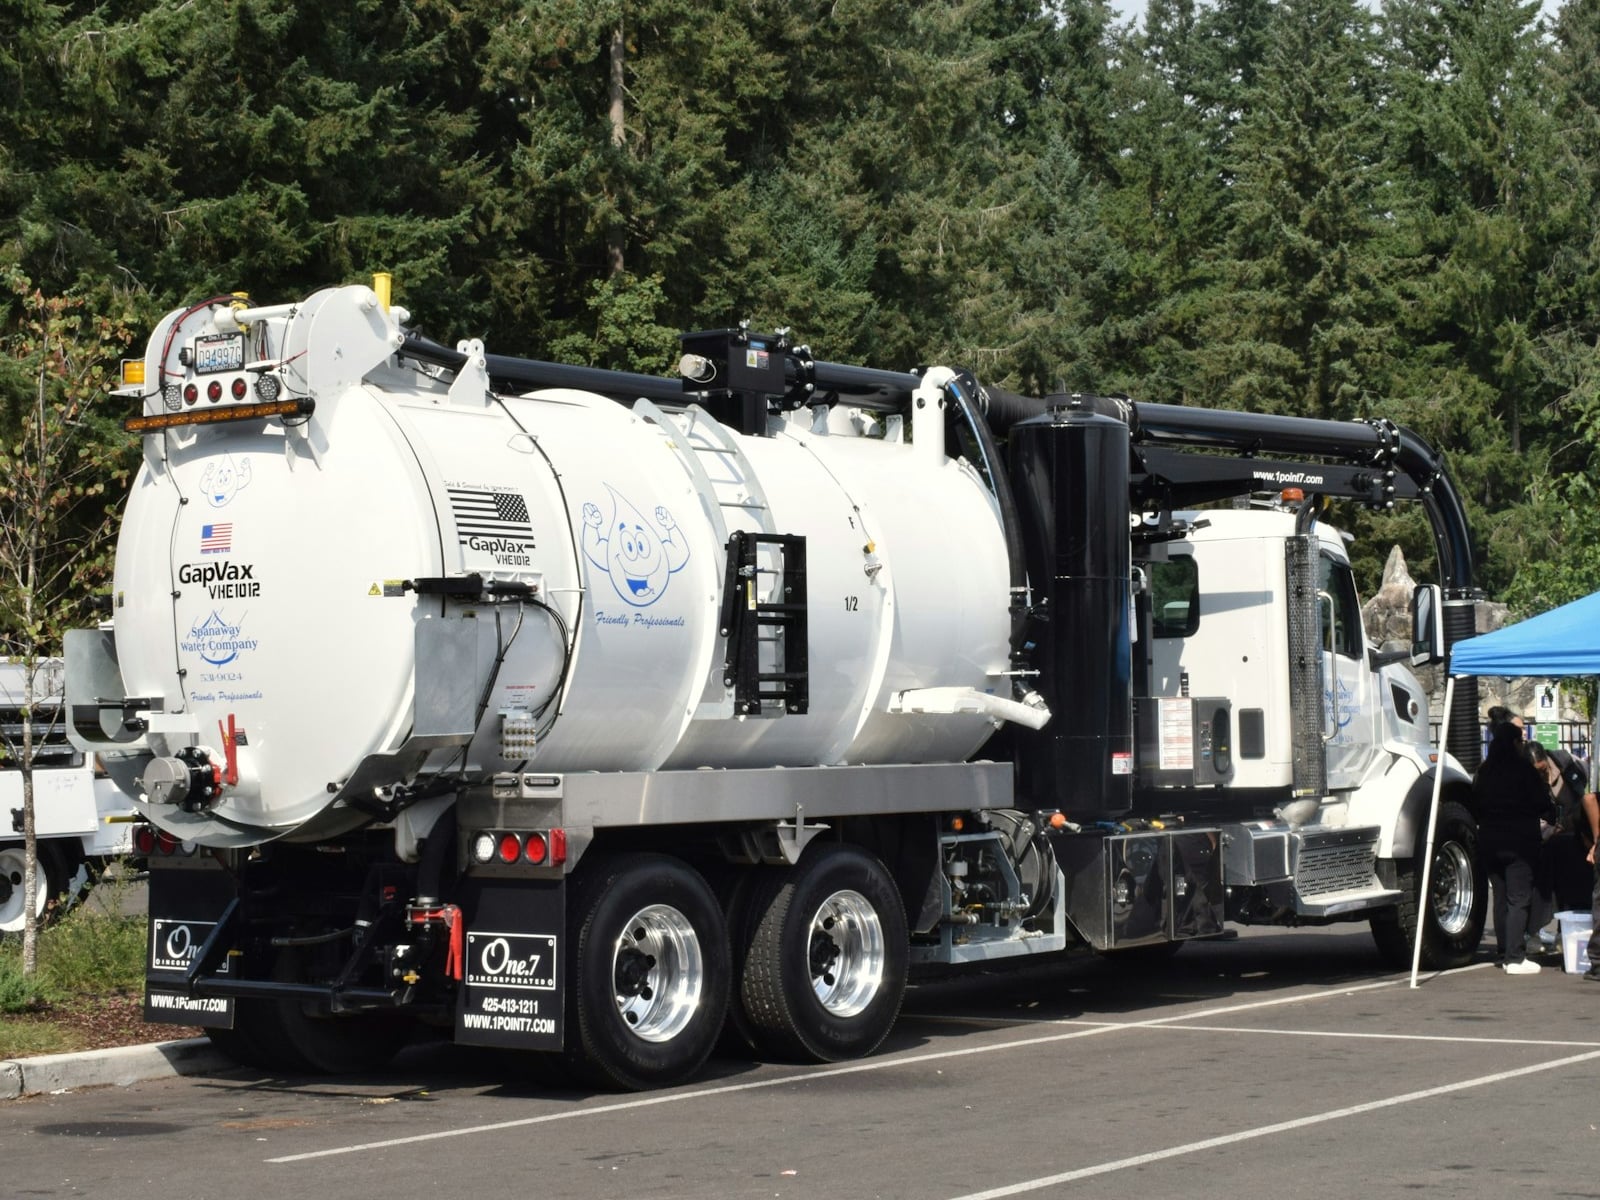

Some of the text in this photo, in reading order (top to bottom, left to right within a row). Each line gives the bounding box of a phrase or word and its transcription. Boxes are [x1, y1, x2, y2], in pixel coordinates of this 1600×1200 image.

[1253, 471, 1323, 484] www.1point7.com
[469, 536, 524, 555] GapVax
[495, 554, 531, 566] VHE1012
[179, 561, 253, 588] GapVax
[208, 582, 260, 600] VHE1012
[844, 596, 858, 612] 1/2
[595, 611, 685, 629] Friendly Professionals
[191, 626, 240, 639] Spanaway
[181, 640, 258, 652] Water Company
[481, 938, 540, 976] One.7
[475, 975, 545, 985] INCORPORATED
[482, 997, 538, 1014] 425-413-1211
[464, 1014, 555, 1033] WWW.1POINT7.COM
